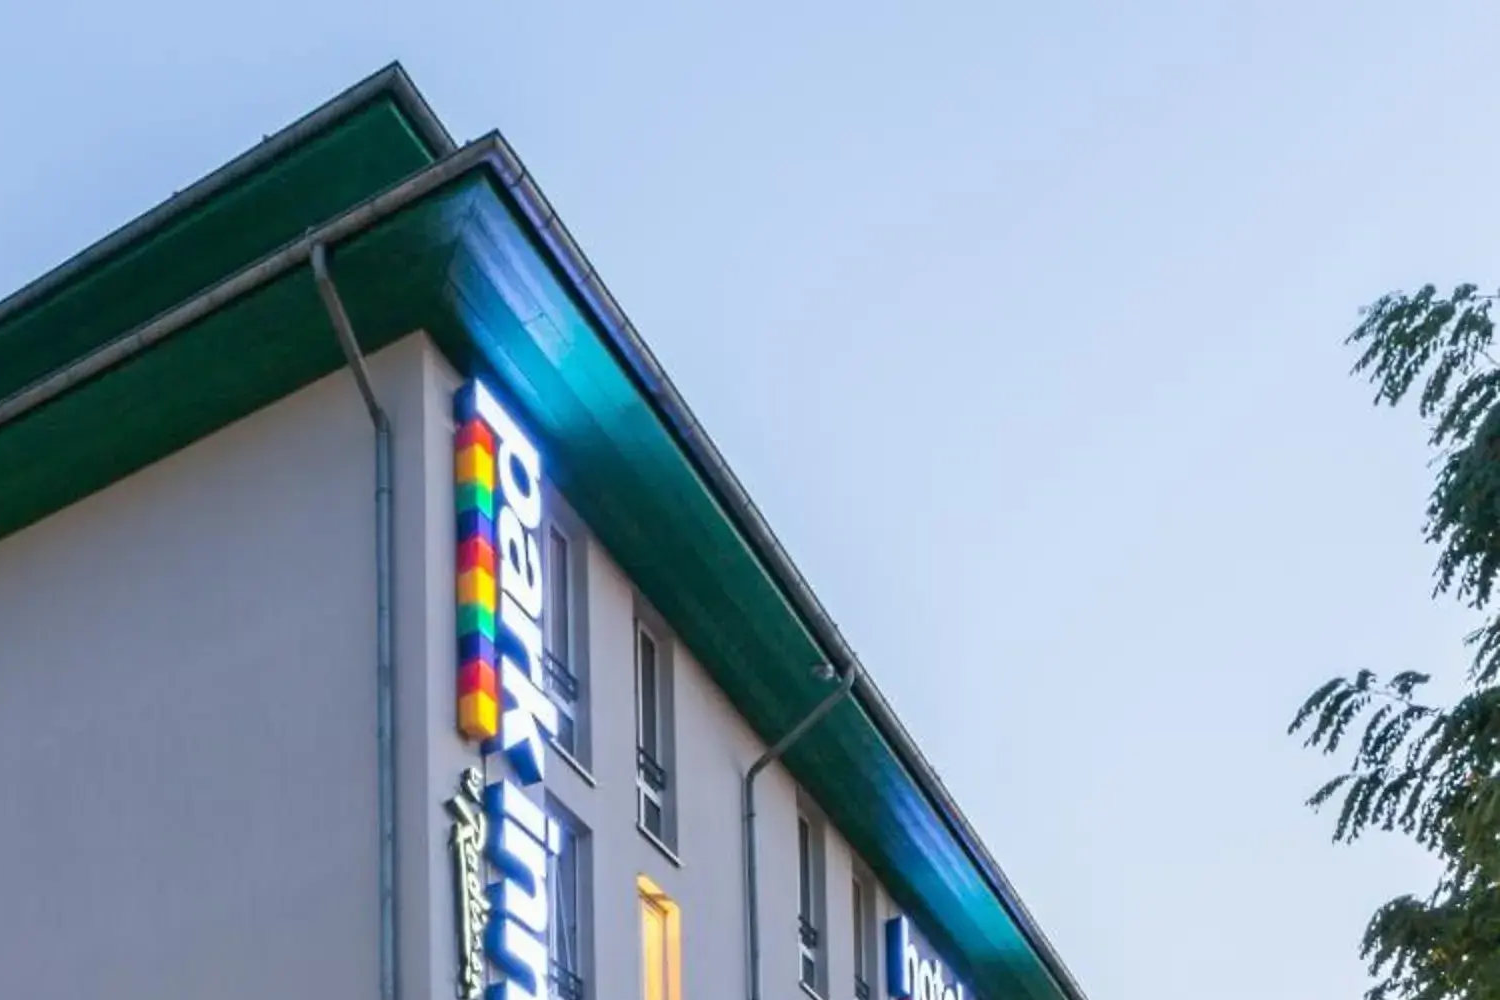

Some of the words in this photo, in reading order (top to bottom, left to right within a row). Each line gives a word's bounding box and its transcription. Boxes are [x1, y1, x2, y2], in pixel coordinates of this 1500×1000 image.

[474, 377, 558, 783] park
[461, 765, 484, 804] by
[452, 793, 492, 1000] Radisson
